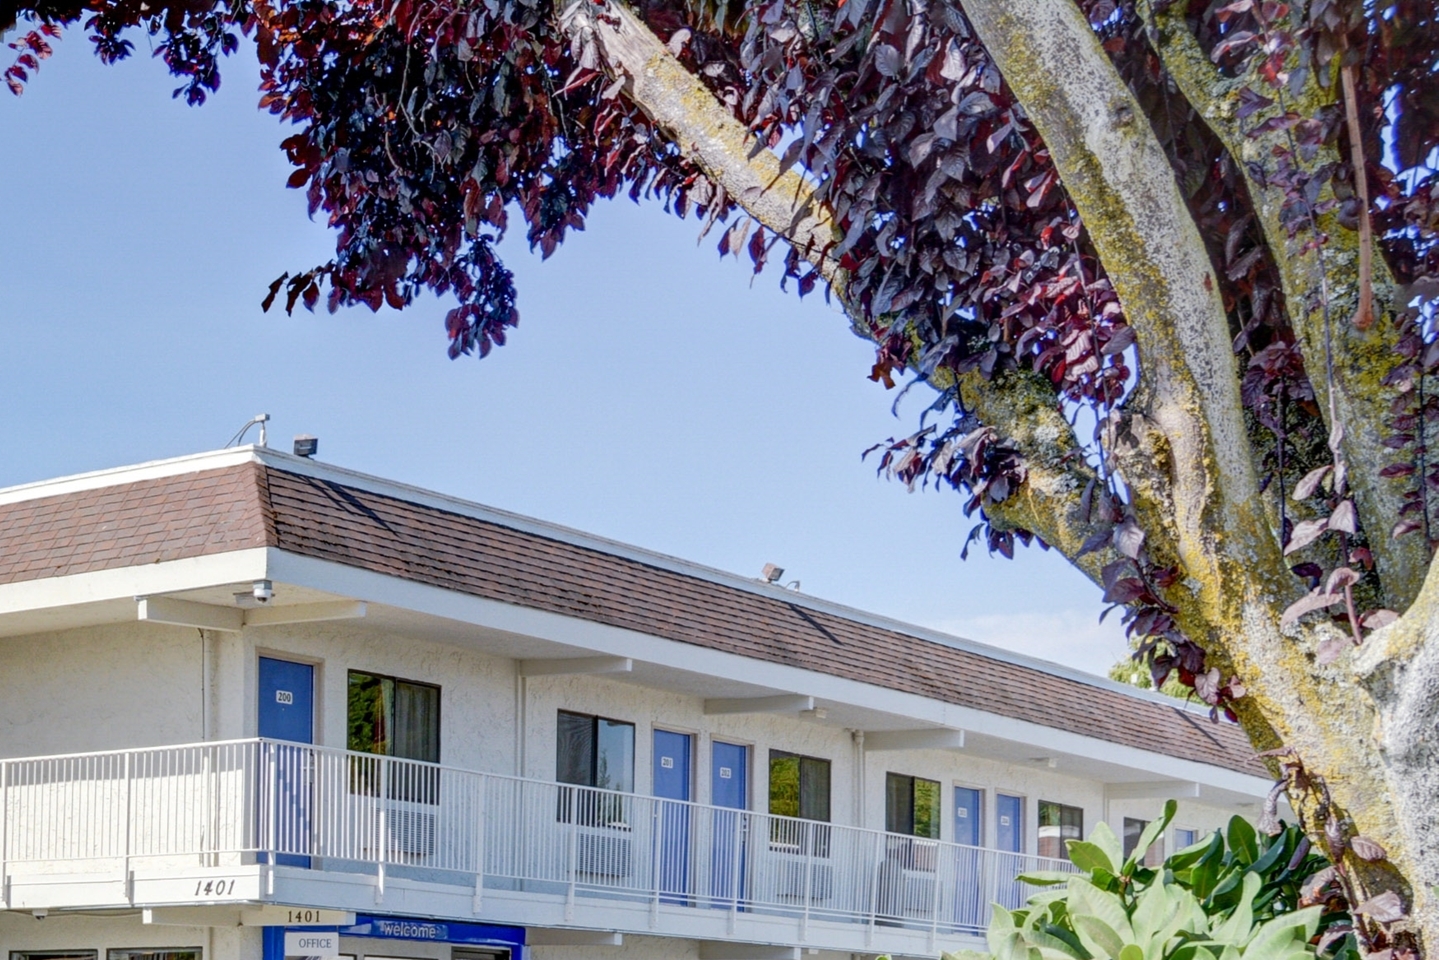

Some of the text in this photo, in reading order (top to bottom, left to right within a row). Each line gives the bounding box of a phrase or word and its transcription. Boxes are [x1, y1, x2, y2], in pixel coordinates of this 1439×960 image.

[277, 692, 292, 703] 200
[194, 880, 235, 897] 1401
[288, 910, 321, 923] 1401
[383, 921, 436, 939] welcome
[298, 938, 332, 949] OFFICE
